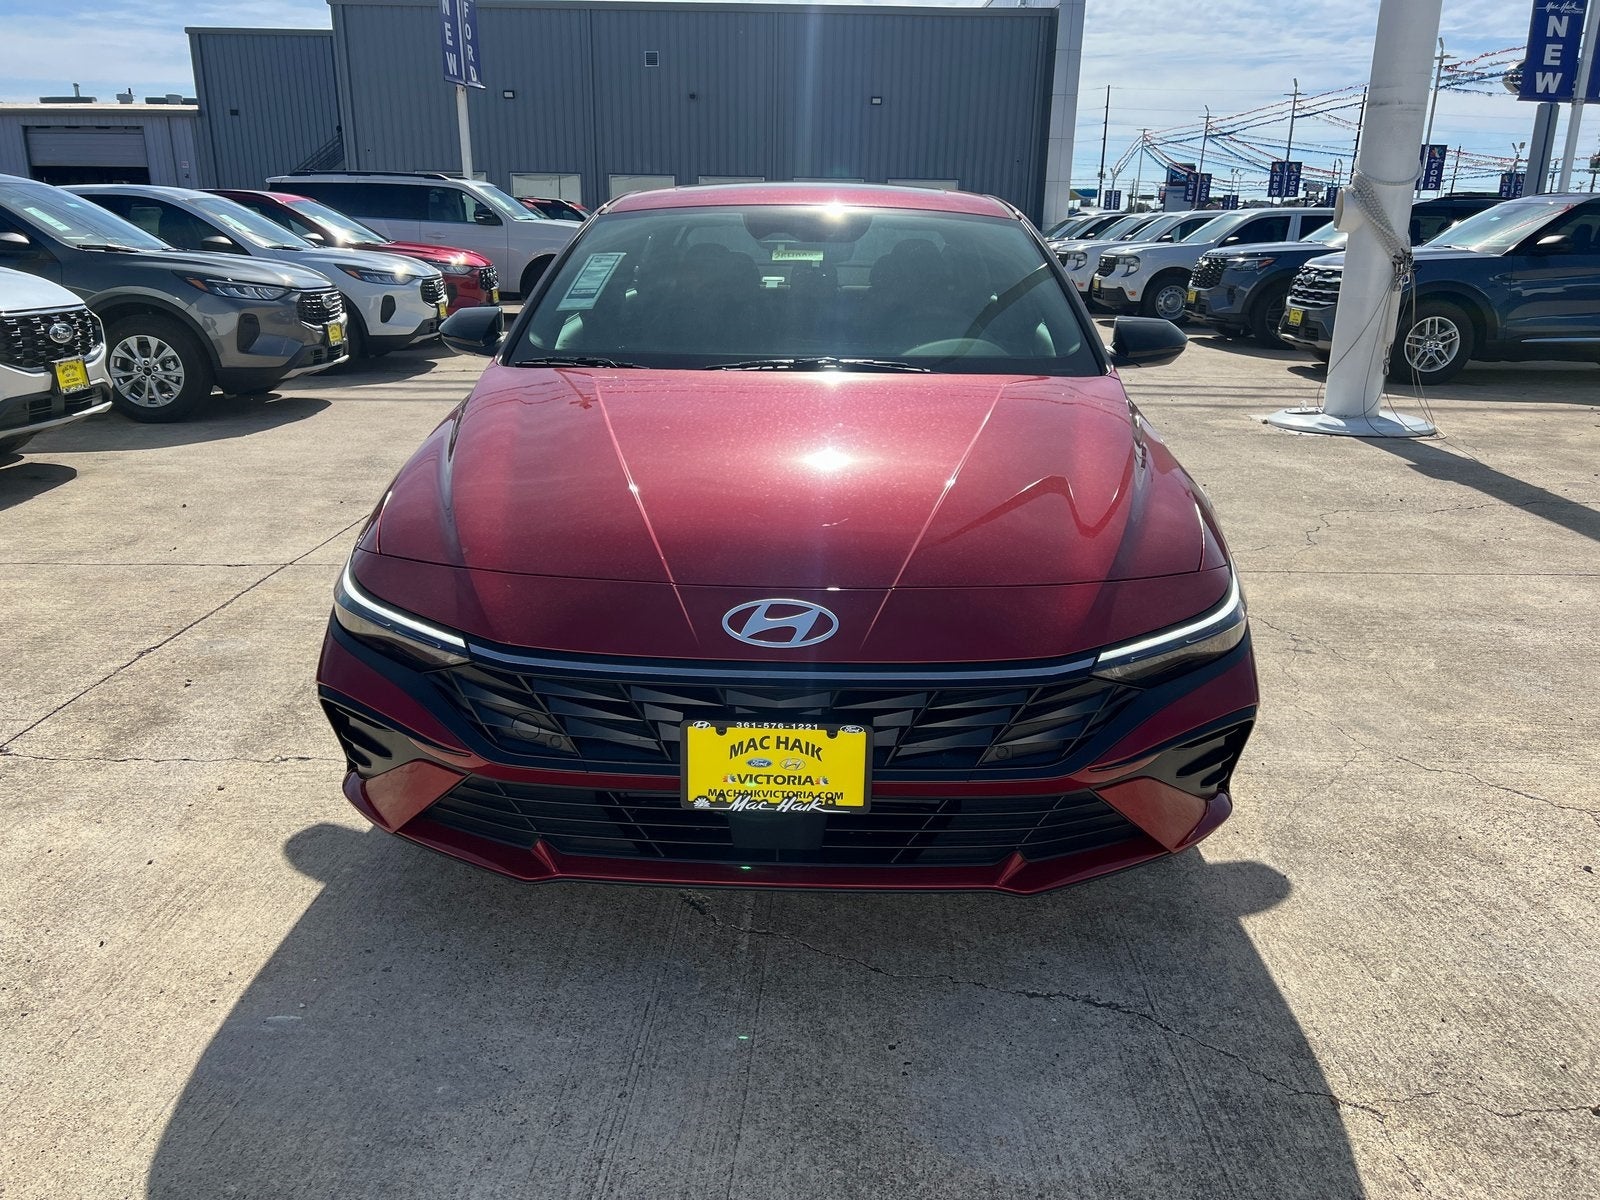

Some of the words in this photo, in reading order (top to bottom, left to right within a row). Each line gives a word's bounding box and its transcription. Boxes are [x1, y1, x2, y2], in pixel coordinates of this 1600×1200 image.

[442, 0, 457, 76] NEW
[463, 1, 477, 82] FORD
[1535, 15, 1569, 94] NEW
[1270, 175, 1280, 196] NEW
[1288, 175, 1297, 196] FORD
[1427, 162, 1439, 189] FORD
[1186, 184, 1194, 201] NEW
[736, 721, 819, 731] 361-576-1221
[729, 735, 771, 760] MAC
[775, 735, 823, 762] HAIK
[736, 773, 815, 786] VICTORIA
[707, 788, 844, 800] MACHAIKVICTORIA.COM
[729, 795, 775, 812] Mac
[776, 796, 824, 813] Haik
